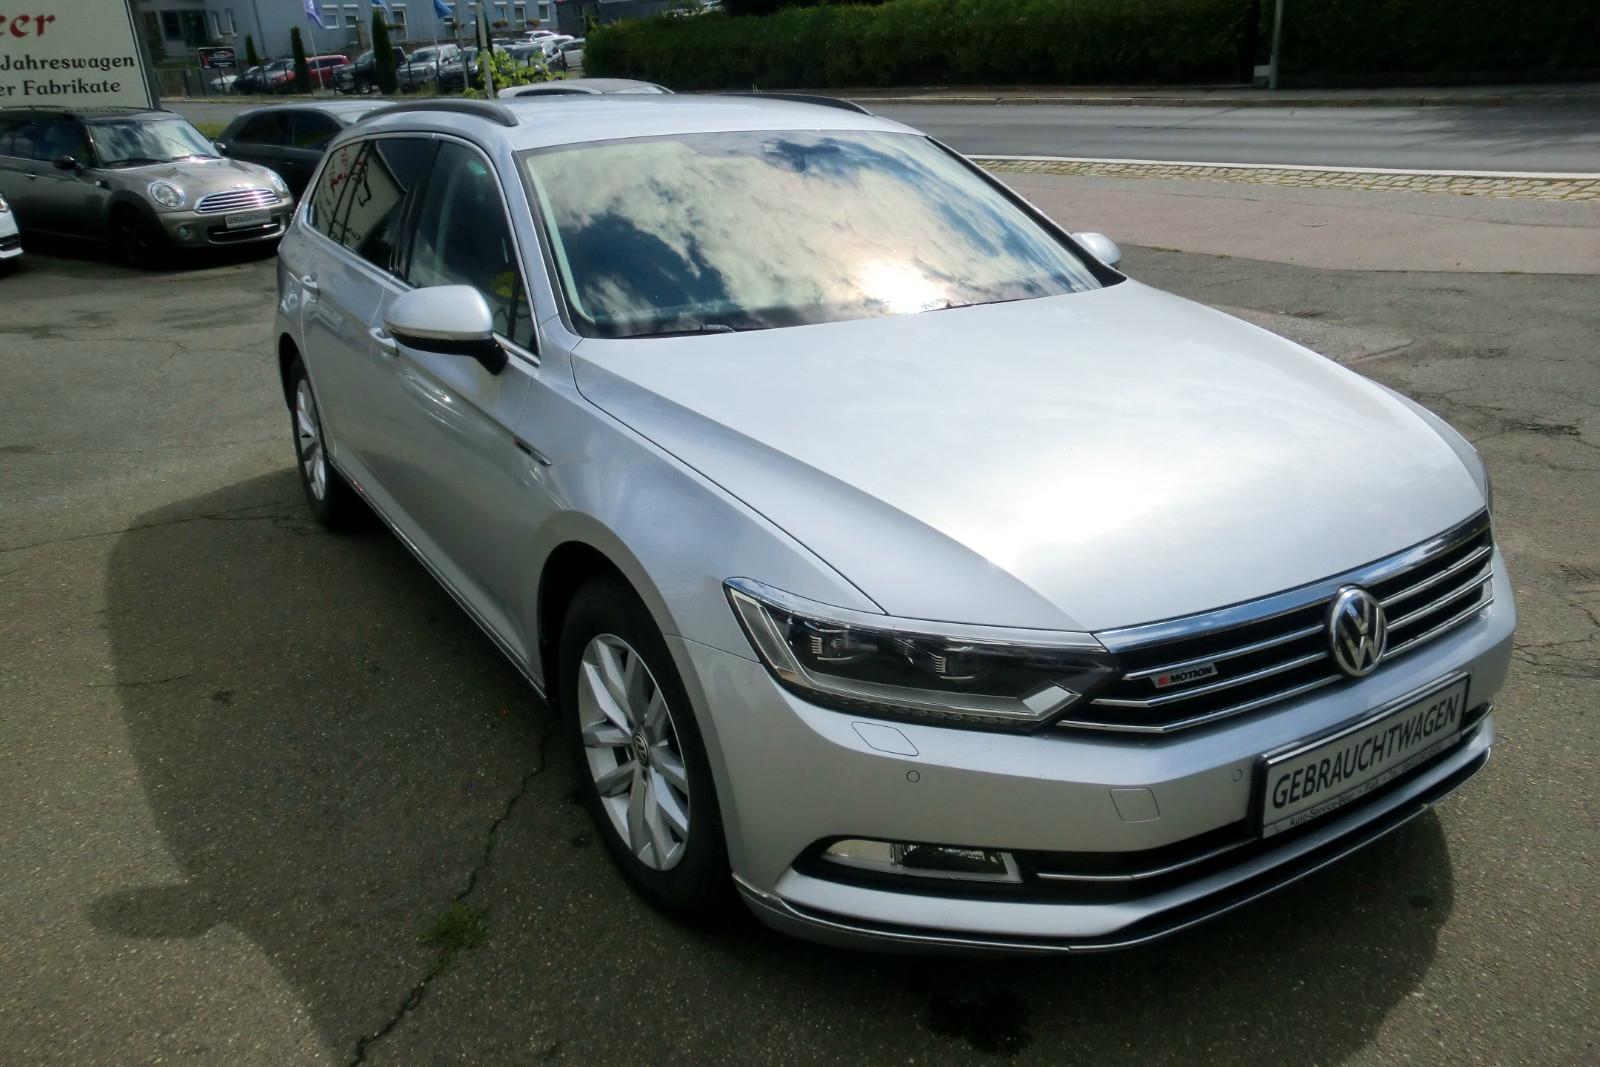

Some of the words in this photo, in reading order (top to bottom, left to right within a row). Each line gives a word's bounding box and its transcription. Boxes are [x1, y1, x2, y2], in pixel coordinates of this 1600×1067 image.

[0, 14, 56, 38] er
[0, 54, 135, 71] Jahreswagen
[23, 78, 121, 96] Fabrikate
[1271, 692, 1461, 810] GEBRAUCHTWAGEN
